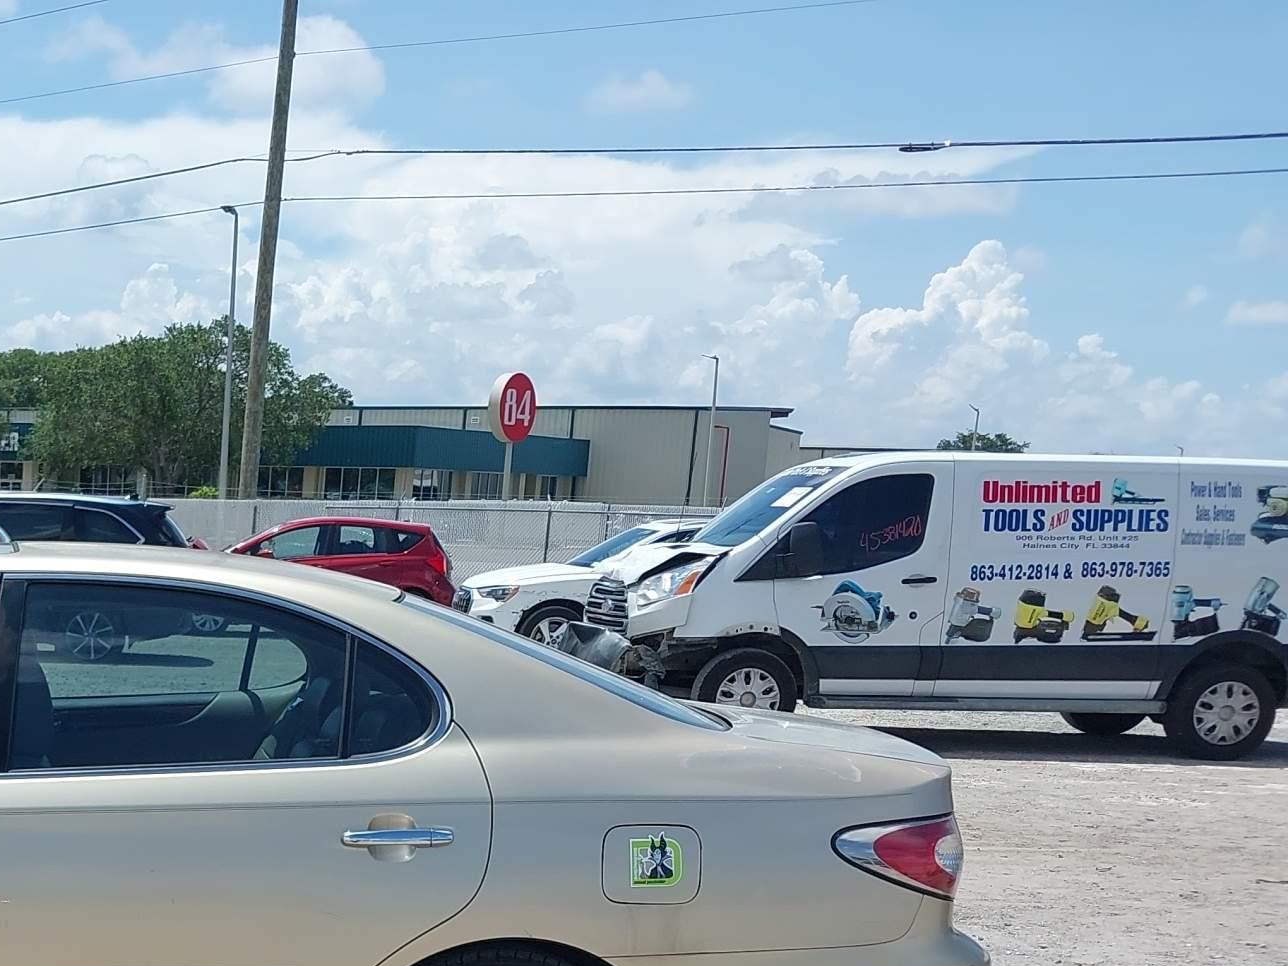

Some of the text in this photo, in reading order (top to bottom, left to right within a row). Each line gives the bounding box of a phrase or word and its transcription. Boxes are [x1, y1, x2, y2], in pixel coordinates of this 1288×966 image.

[504, 388, 531, 427] 84
[983, 480, 1101, 504] Unlimited
[982, 509, 1169, 532] TOOLS AND SUPPLIES
[970, 561, 1170, 581] 863-412-2814 & 863-978-7365
